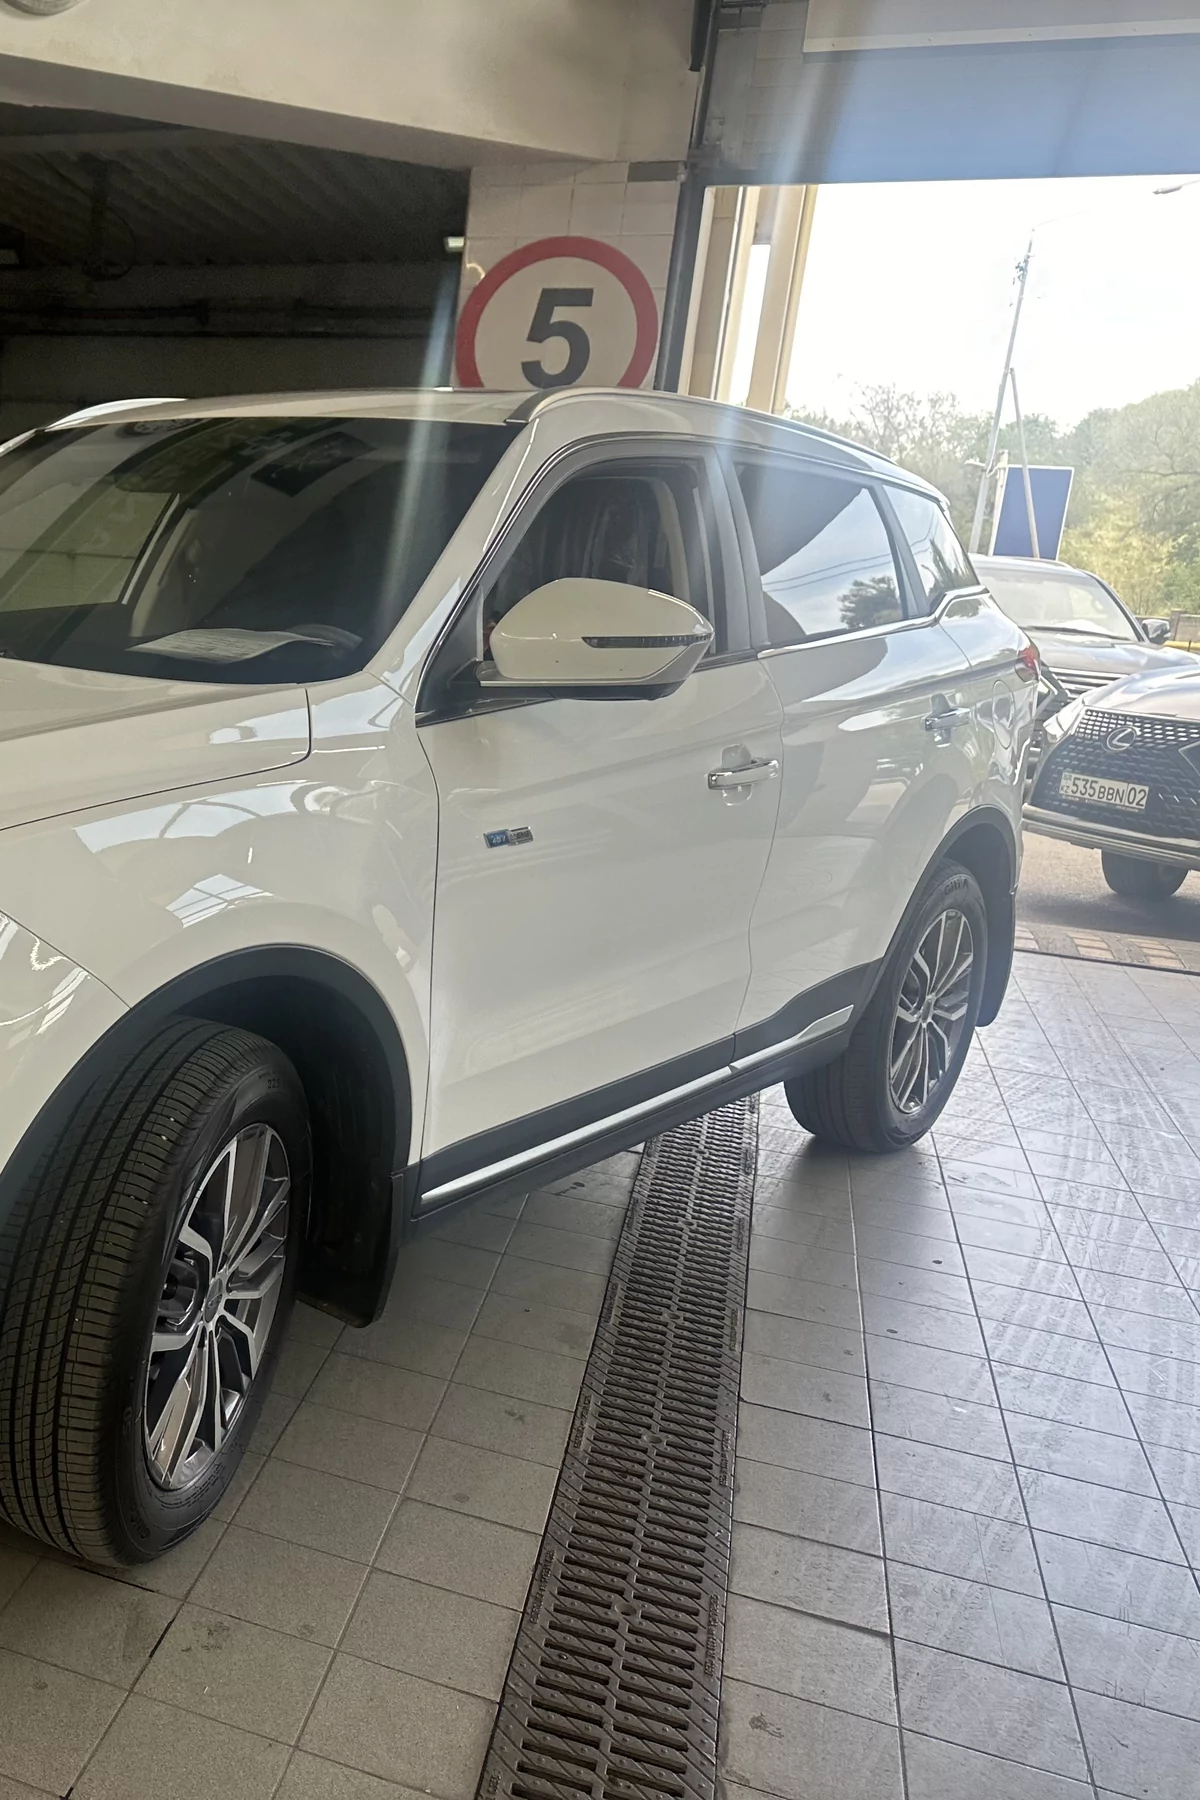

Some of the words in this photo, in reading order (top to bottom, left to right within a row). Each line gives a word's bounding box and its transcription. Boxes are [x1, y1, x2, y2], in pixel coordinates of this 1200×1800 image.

[521, 287, 595, 389] 5
[1070, 777, 1125, 804] 535BBN
[1126, 787, 1147, 807] 02
